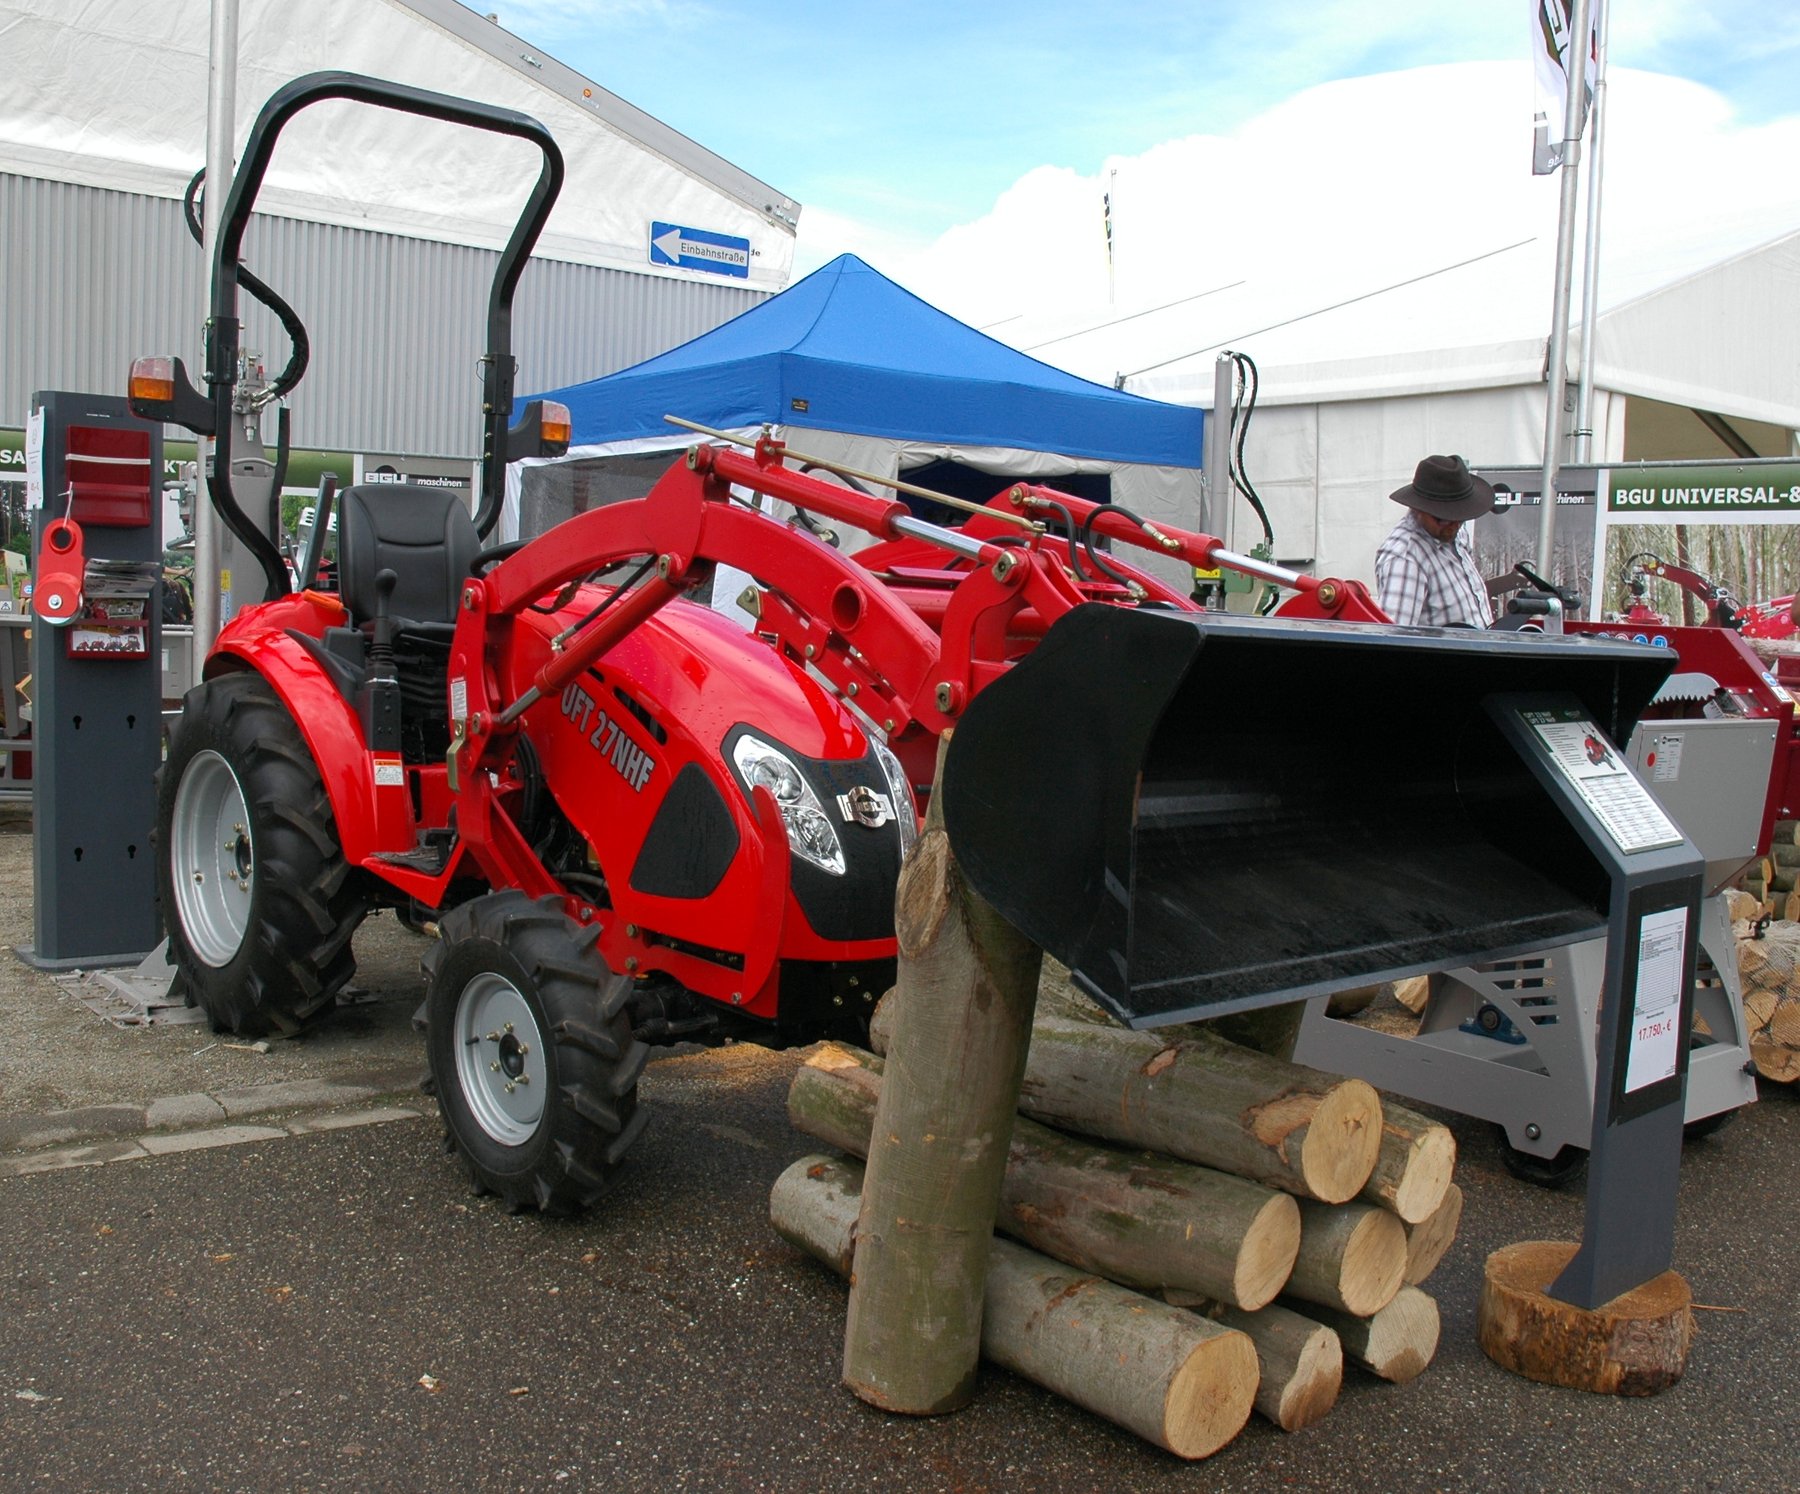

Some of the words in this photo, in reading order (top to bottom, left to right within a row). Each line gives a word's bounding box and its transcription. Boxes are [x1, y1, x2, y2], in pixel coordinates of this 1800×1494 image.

[681, 242, 744, 263] Einbahnstraße
[365, 472, 407, 484] BGU
[417, 477, 462, 487] maschinen
[1494, 492, 1522, 505] GU
[1616, 488, 1656, 505] BGU
[562, 682, 595, 733] UFT
[1638, 1023, 1666, 1041] 17.750,-
[1666, 1019, 1672, 1031] €
